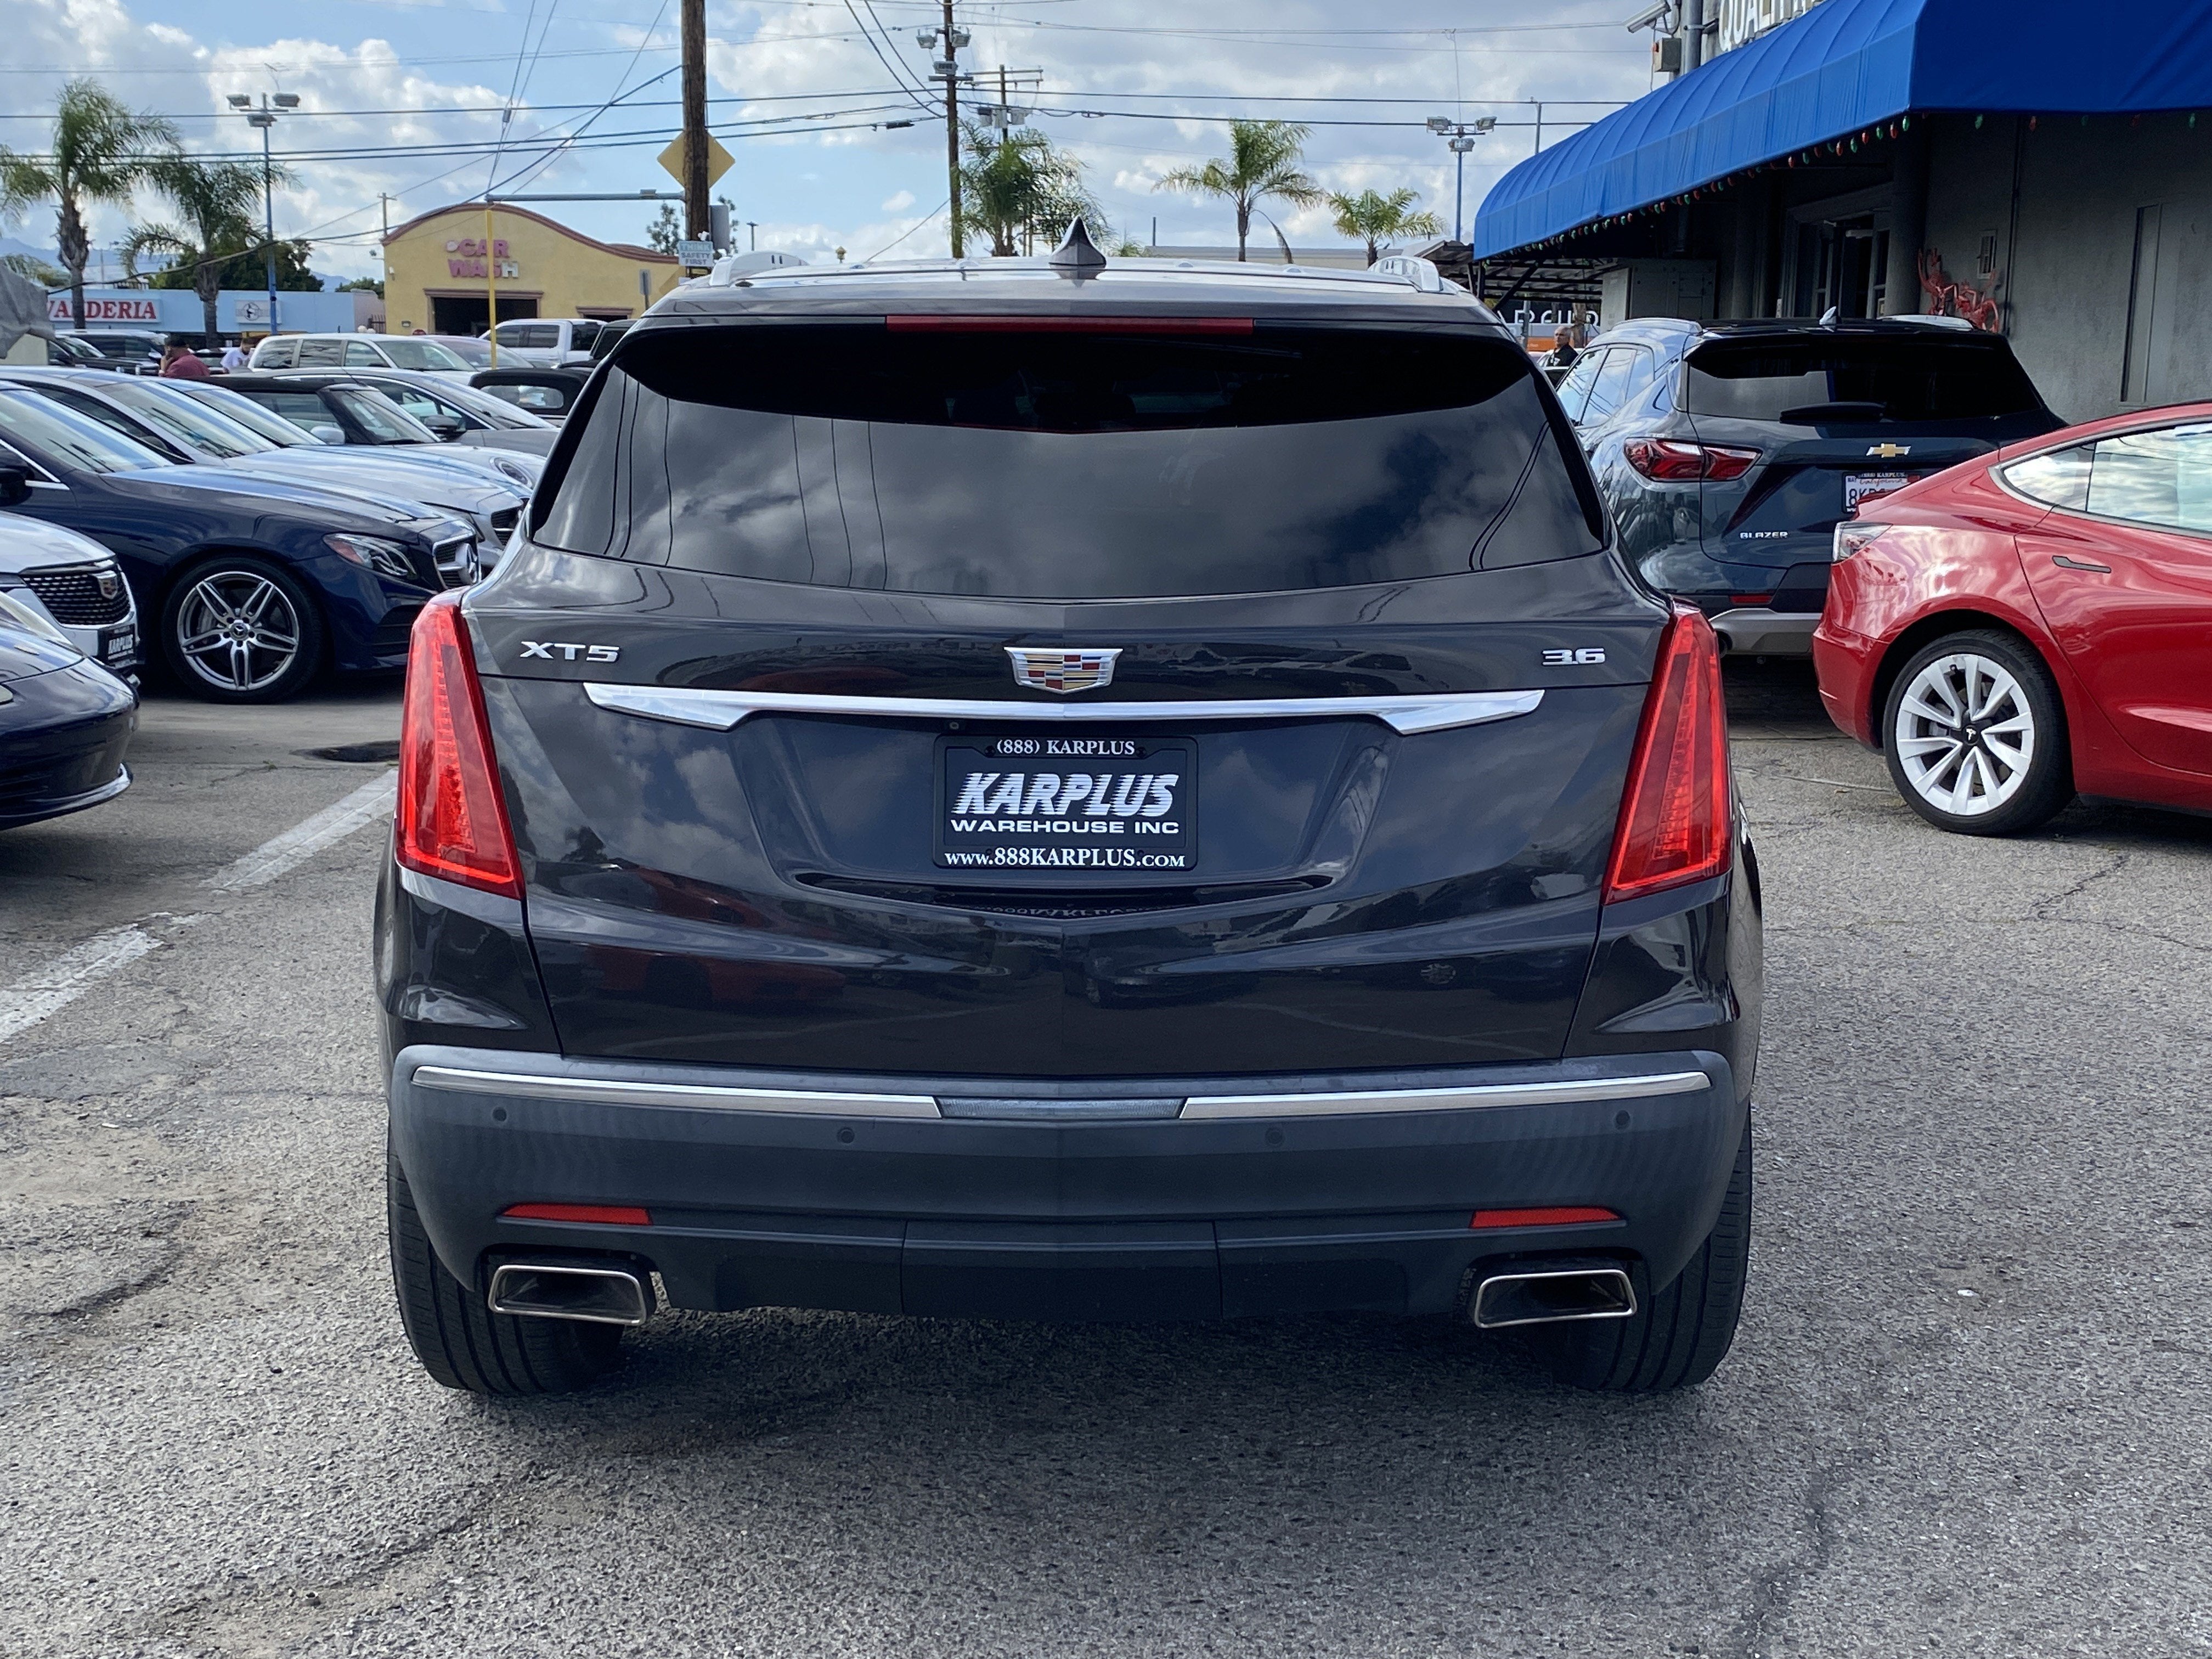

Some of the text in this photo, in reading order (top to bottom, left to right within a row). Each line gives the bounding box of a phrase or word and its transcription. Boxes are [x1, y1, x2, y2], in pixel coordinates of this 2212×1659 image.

[459, 239, 509, 257] CAR
[448, 259, 519, 278] WASH
[48, 301, 156, 319] ADERIA
[520, 641, 619, 662] XT5
[1542, 648, 1605, 665] 3.6
[996, 740, 1135, 755] (888) KARPLUS
[951, 772, 1180, 816] KARPLUS
[950, 819, 1180, 834] WAREHOUSE INC
